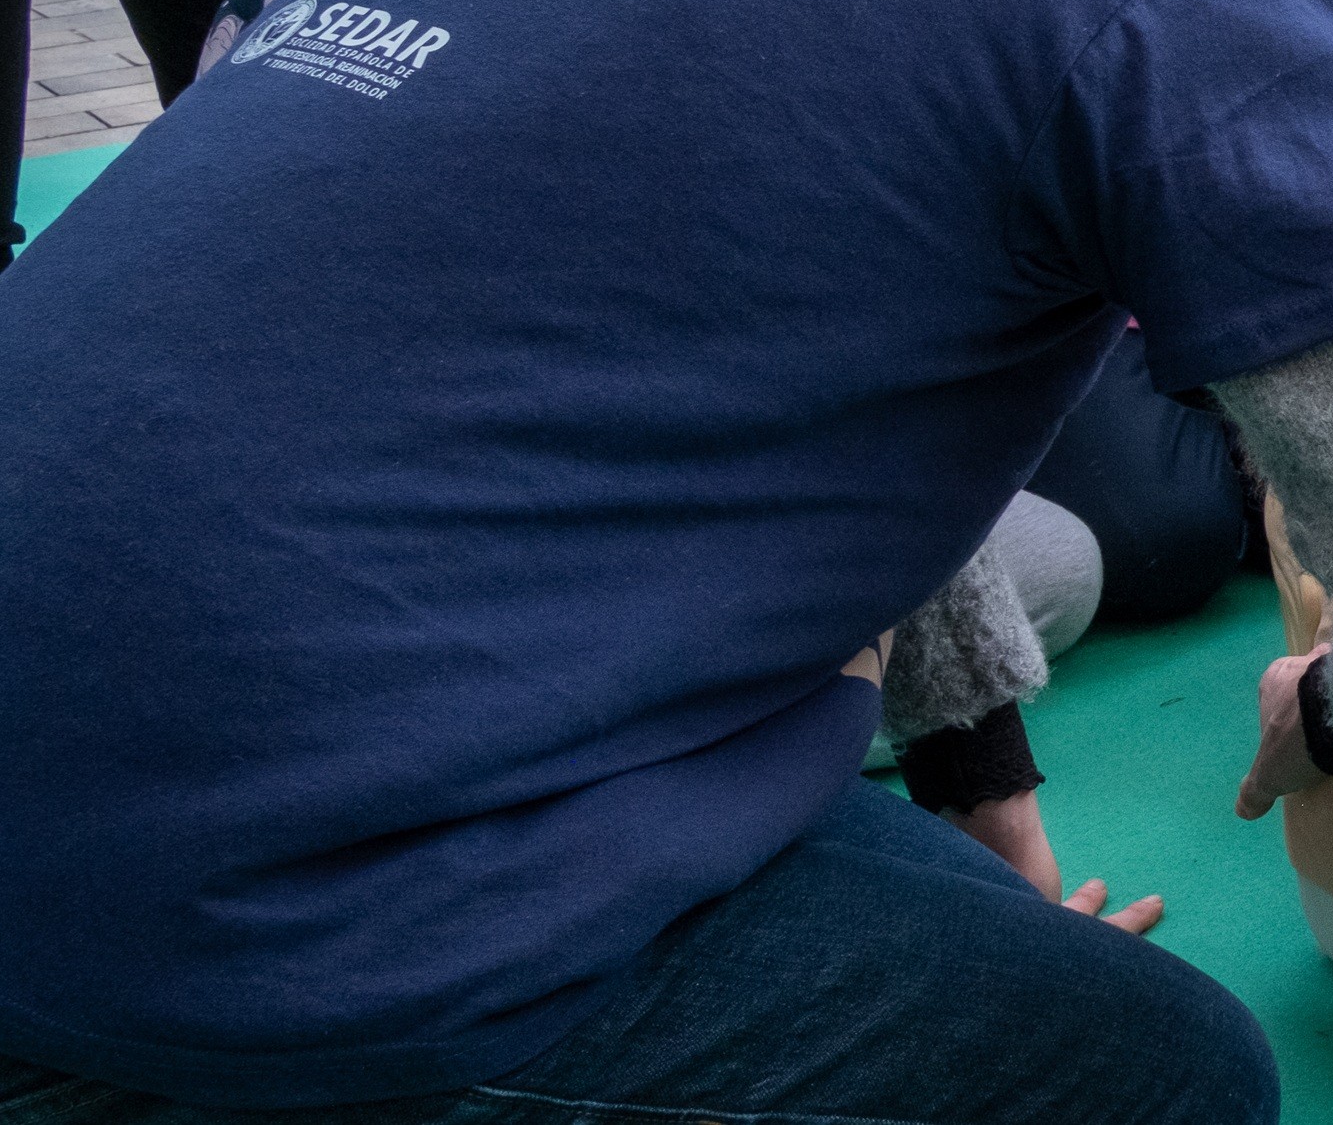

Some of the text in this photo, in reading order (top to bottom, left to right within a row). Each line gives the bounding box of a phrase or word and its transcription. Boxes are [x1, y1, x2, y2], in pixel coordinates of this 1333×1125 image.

[298, 2, 450, 69] SEDAR
[286, 37, 415, 78] SOCIEDAD ESPAÑOLA DE
[325, 72, 348, 85] DEL
[346, 79, 388, 100] DOLOR
[335, 61, 403, 89] REANIMACIÓN
